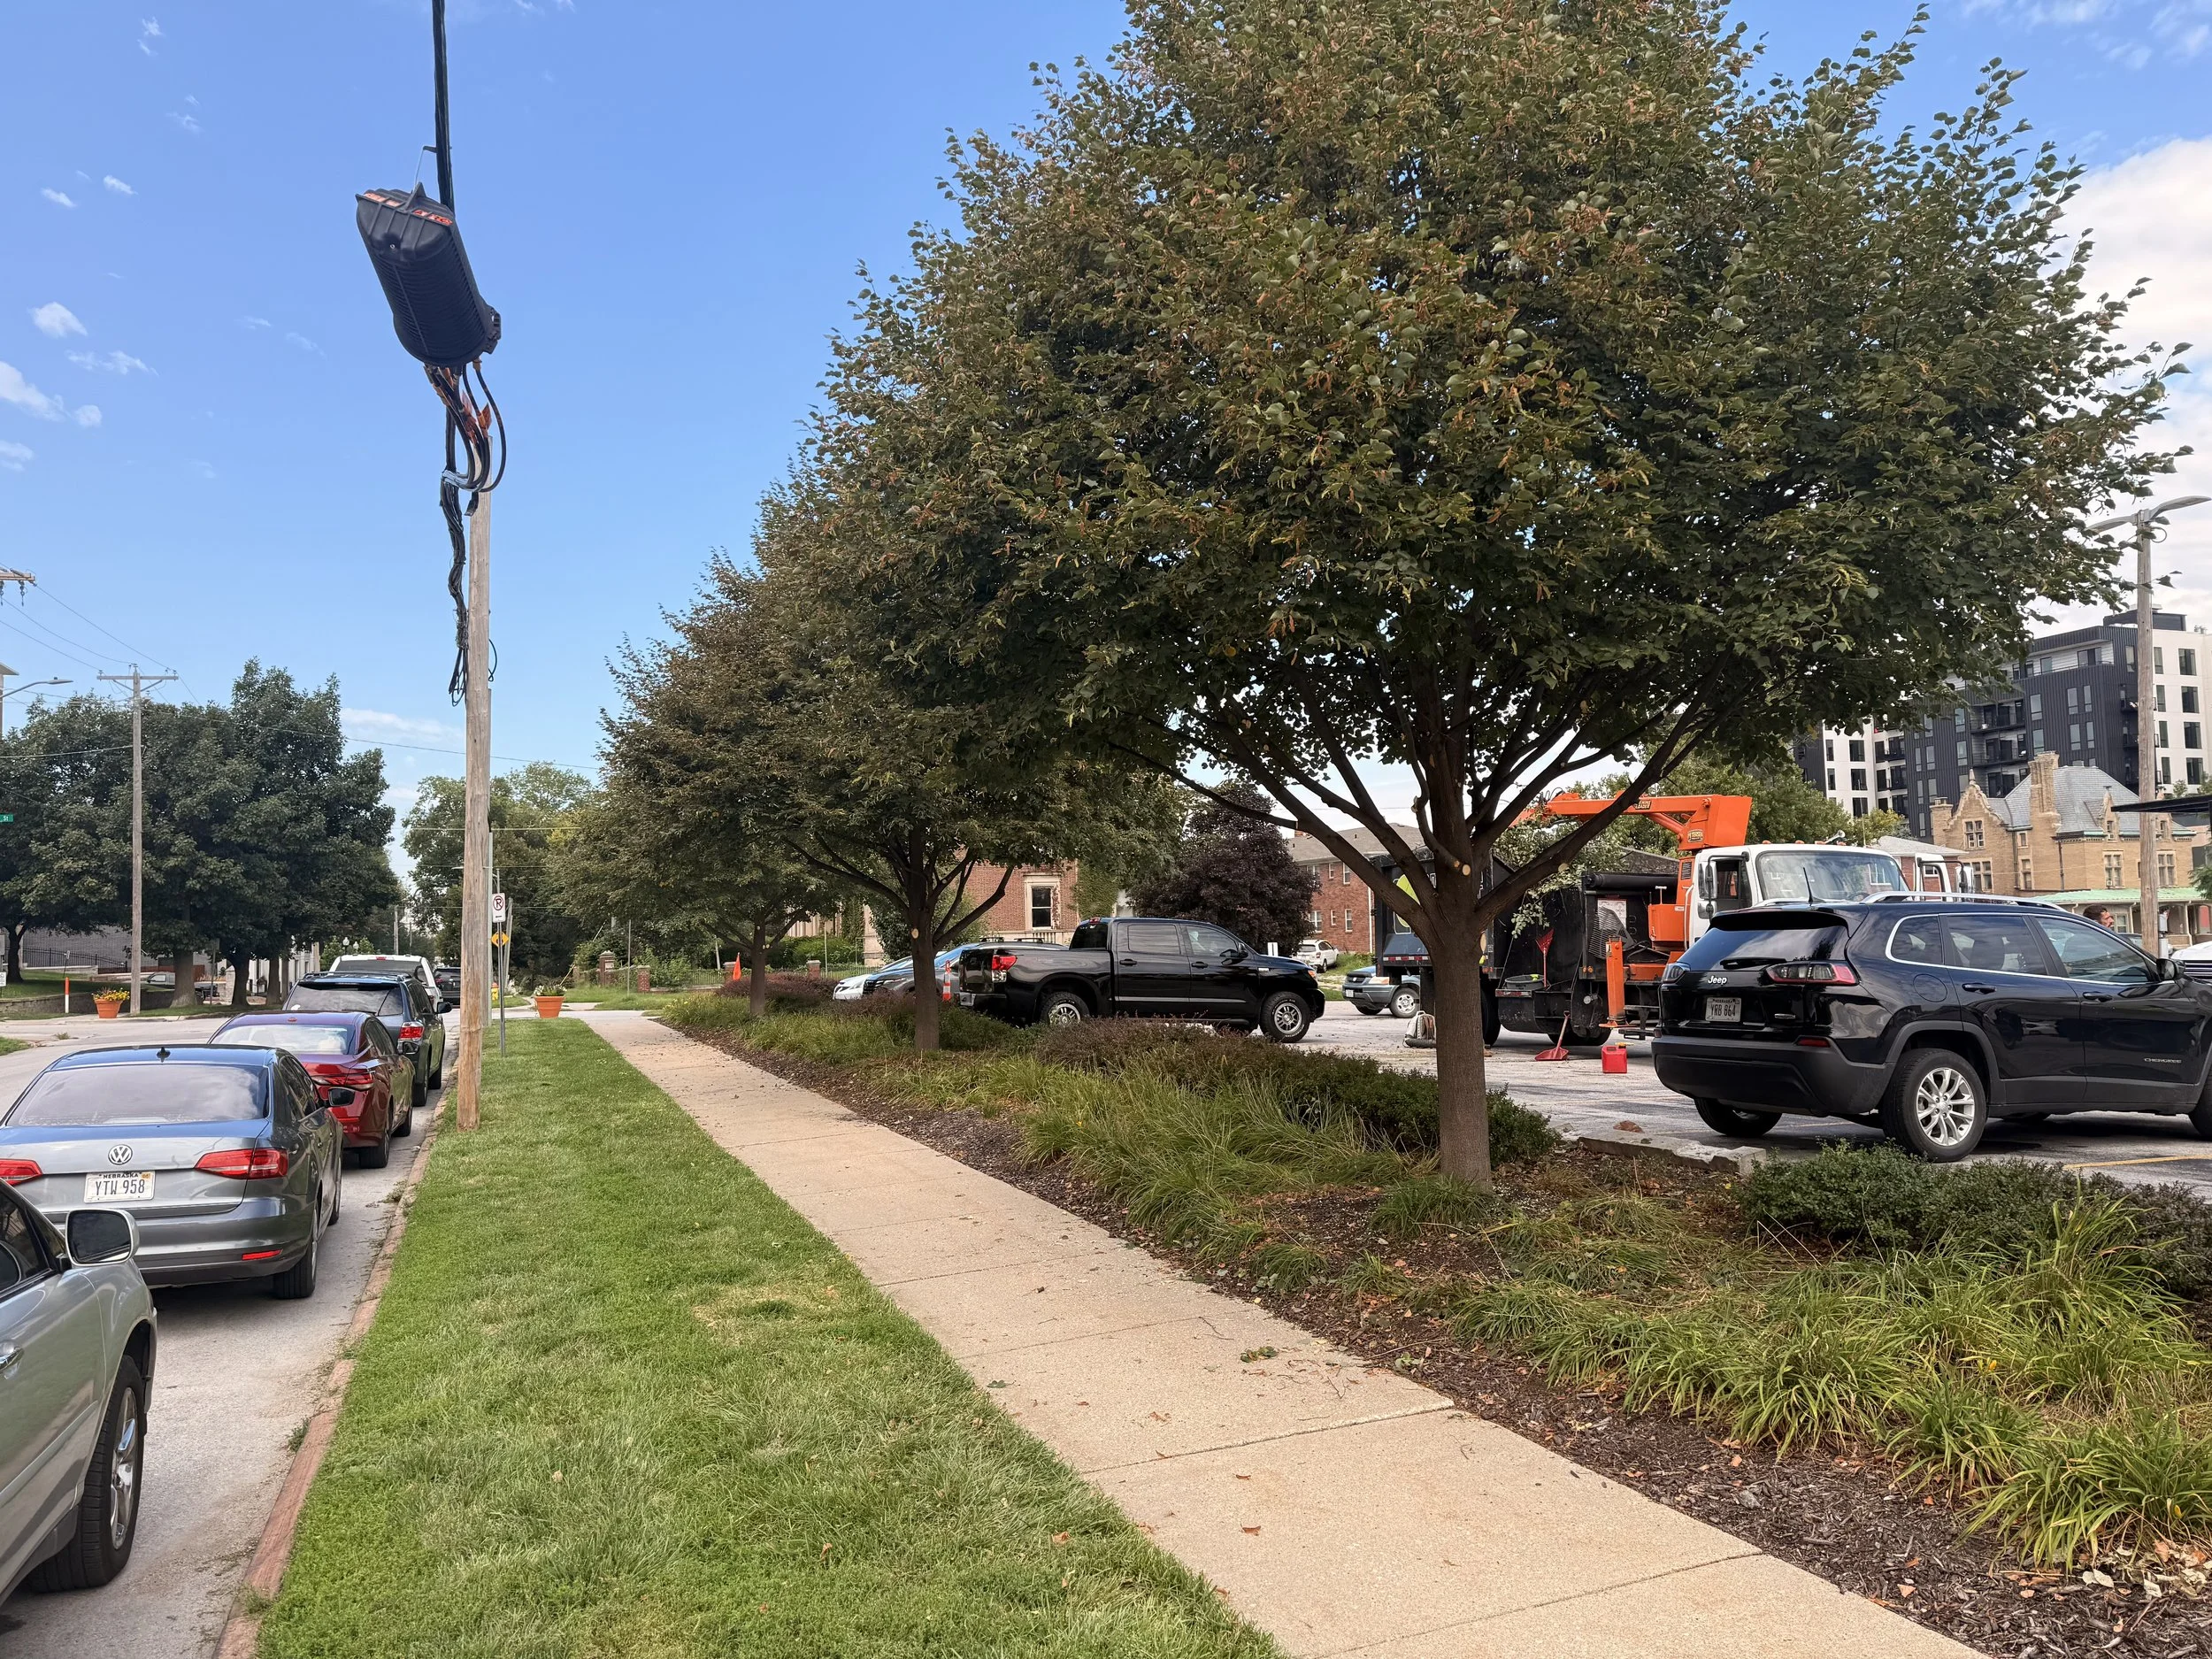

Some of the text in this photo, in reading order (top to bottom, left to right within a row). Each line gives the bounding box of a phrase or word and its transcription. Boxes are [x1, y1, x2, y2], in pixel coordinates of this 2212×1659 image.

[1708, 976, 1727, 986] Jeep
[96, 1179, 145, 1195] YTW 958
